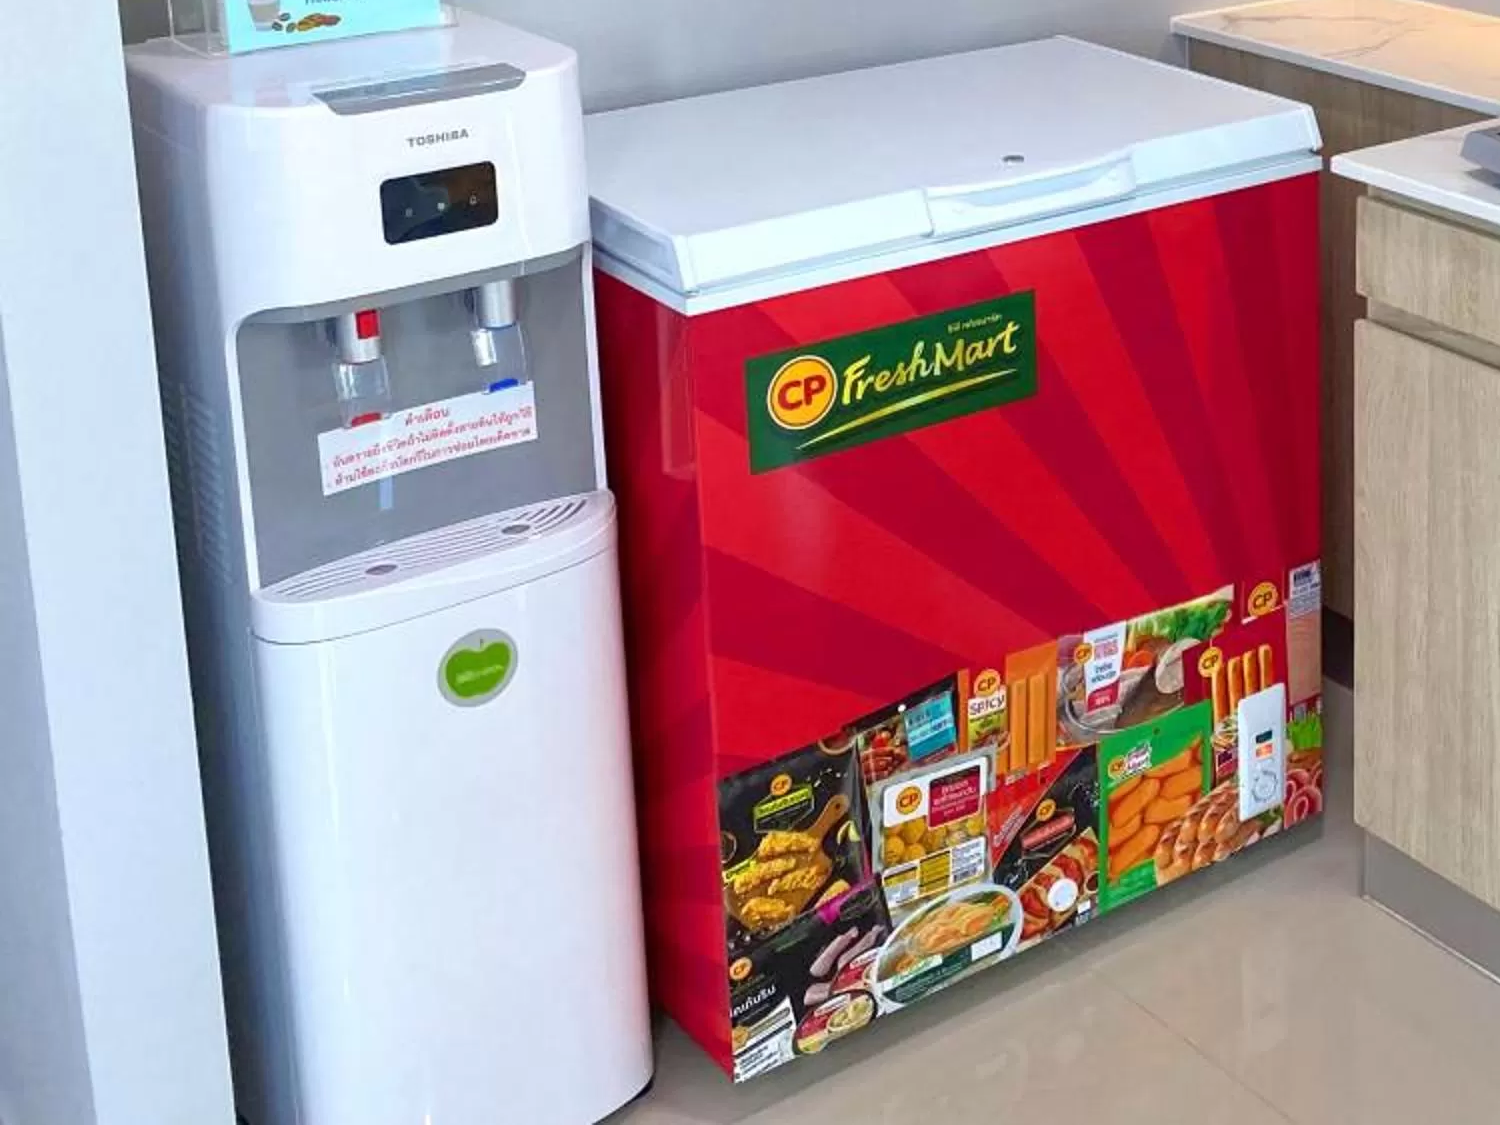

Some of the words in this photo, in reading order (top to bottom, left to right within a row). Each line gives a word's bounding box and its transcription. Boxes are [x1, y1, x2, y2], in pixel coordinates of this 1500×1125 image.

[405, 128, 469, 148] TOSHIBA
[777, 375, 827, 411] CP
[1253, 591, 1274, 610] CP
[1202, 653, 1220, 670] CP
[977, 675, 998, 693] CP
[898, 791, 921, 810] CP
